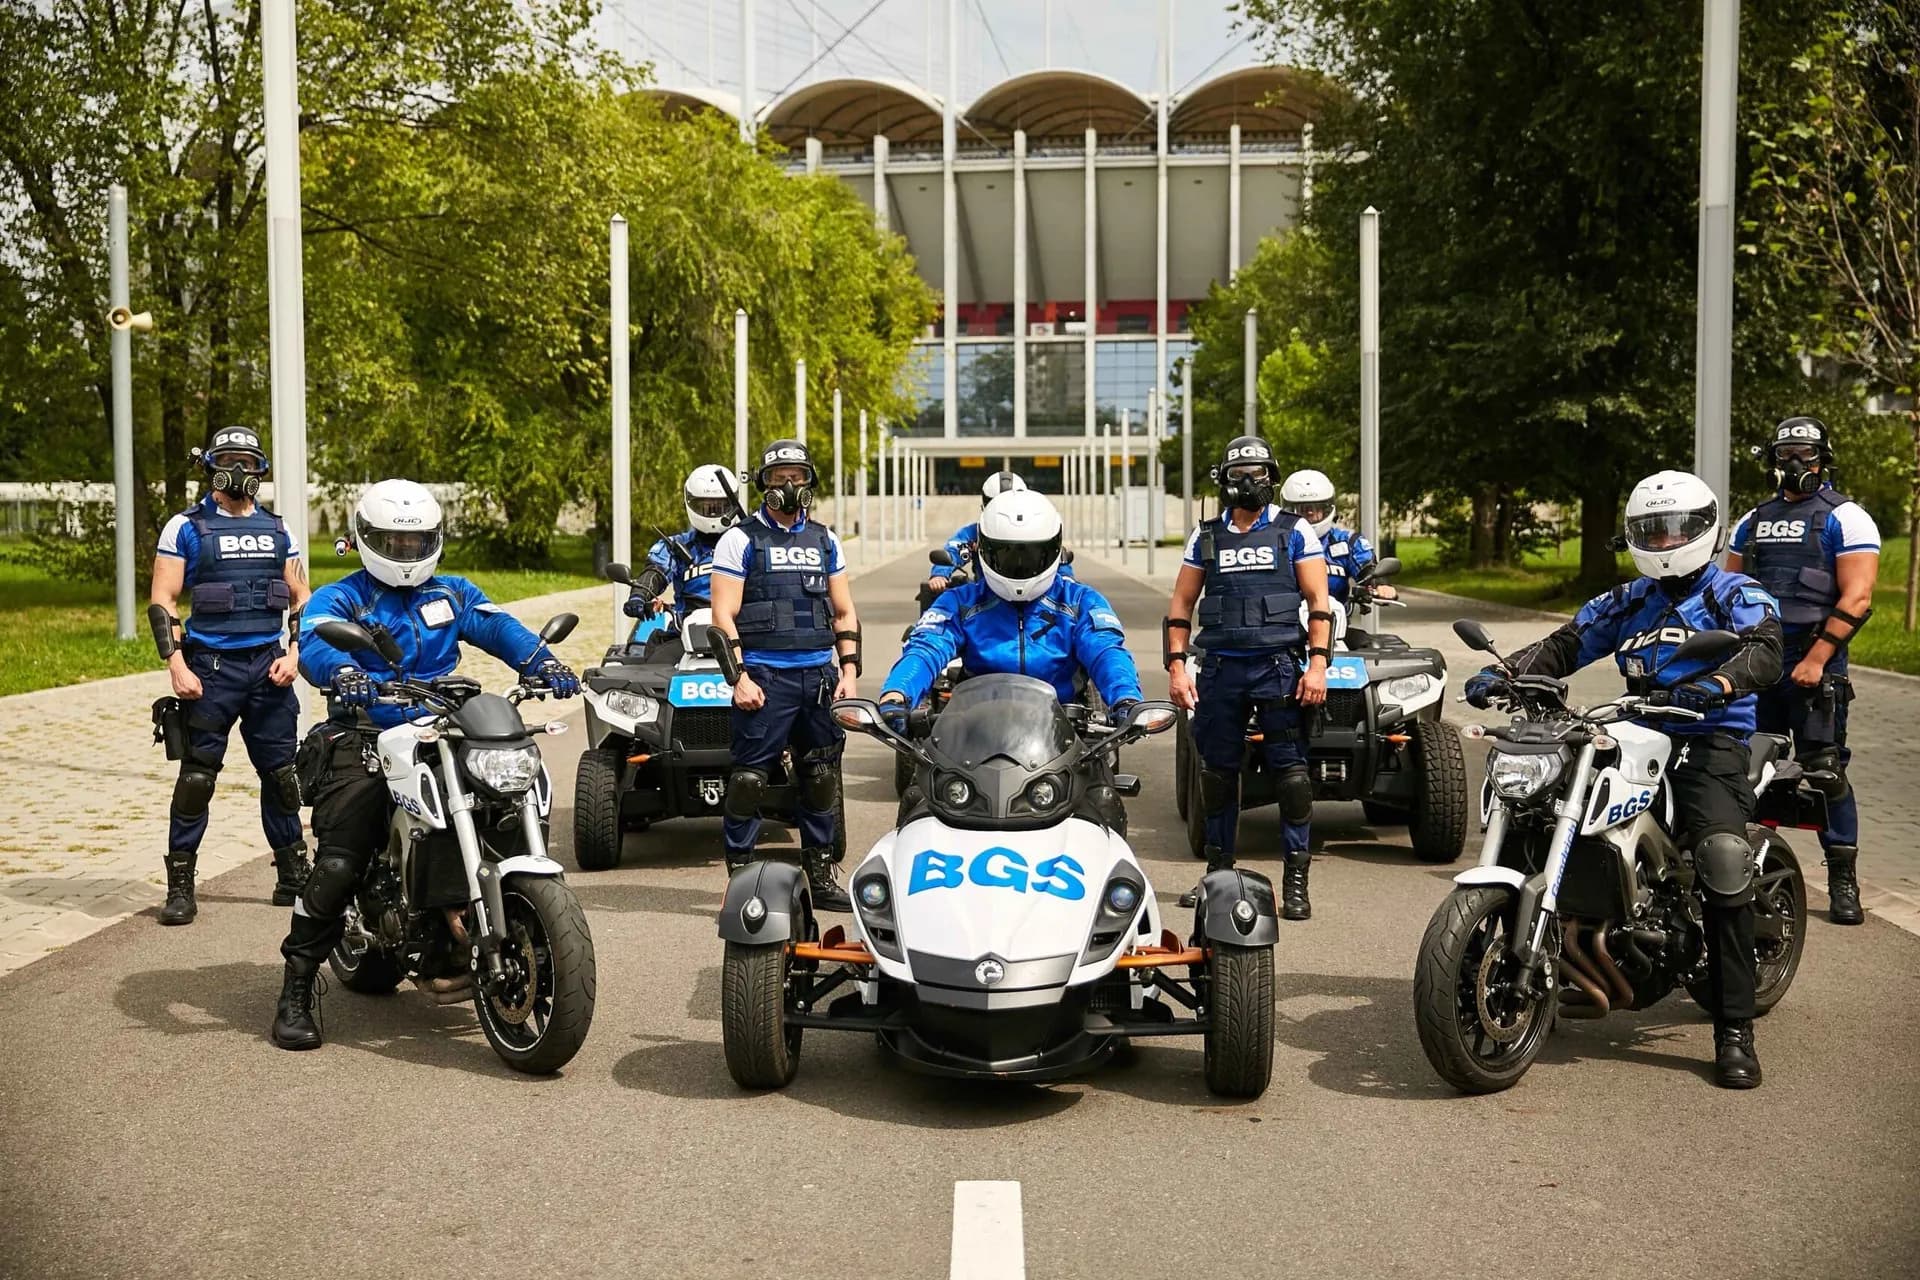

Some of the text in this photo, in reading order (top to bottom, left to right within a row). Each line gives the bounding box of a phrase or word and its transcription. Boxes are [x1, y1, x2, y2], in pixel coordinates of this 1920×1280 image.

[215, 432, 259, 447] BGS
[1778, 425, 1821, 440] BGS
[765, 448, 807, 464] BGS
[1228, 446, 1269, 461] BGS
[1756, 520, 1806, 537] BGS
[219, 534, 275, 552] BGS
[769, 546, 822, 565] BGS
[1219, 546, 1274, 567] BGS
[1325, 666, 1357, 680] GS
[682, 681, 734, 699] BGS
[392, 789, 421, 815] BGS
[1606, 790, 1651, 825] BGS
[908, 846, 1086, 901] BGS
